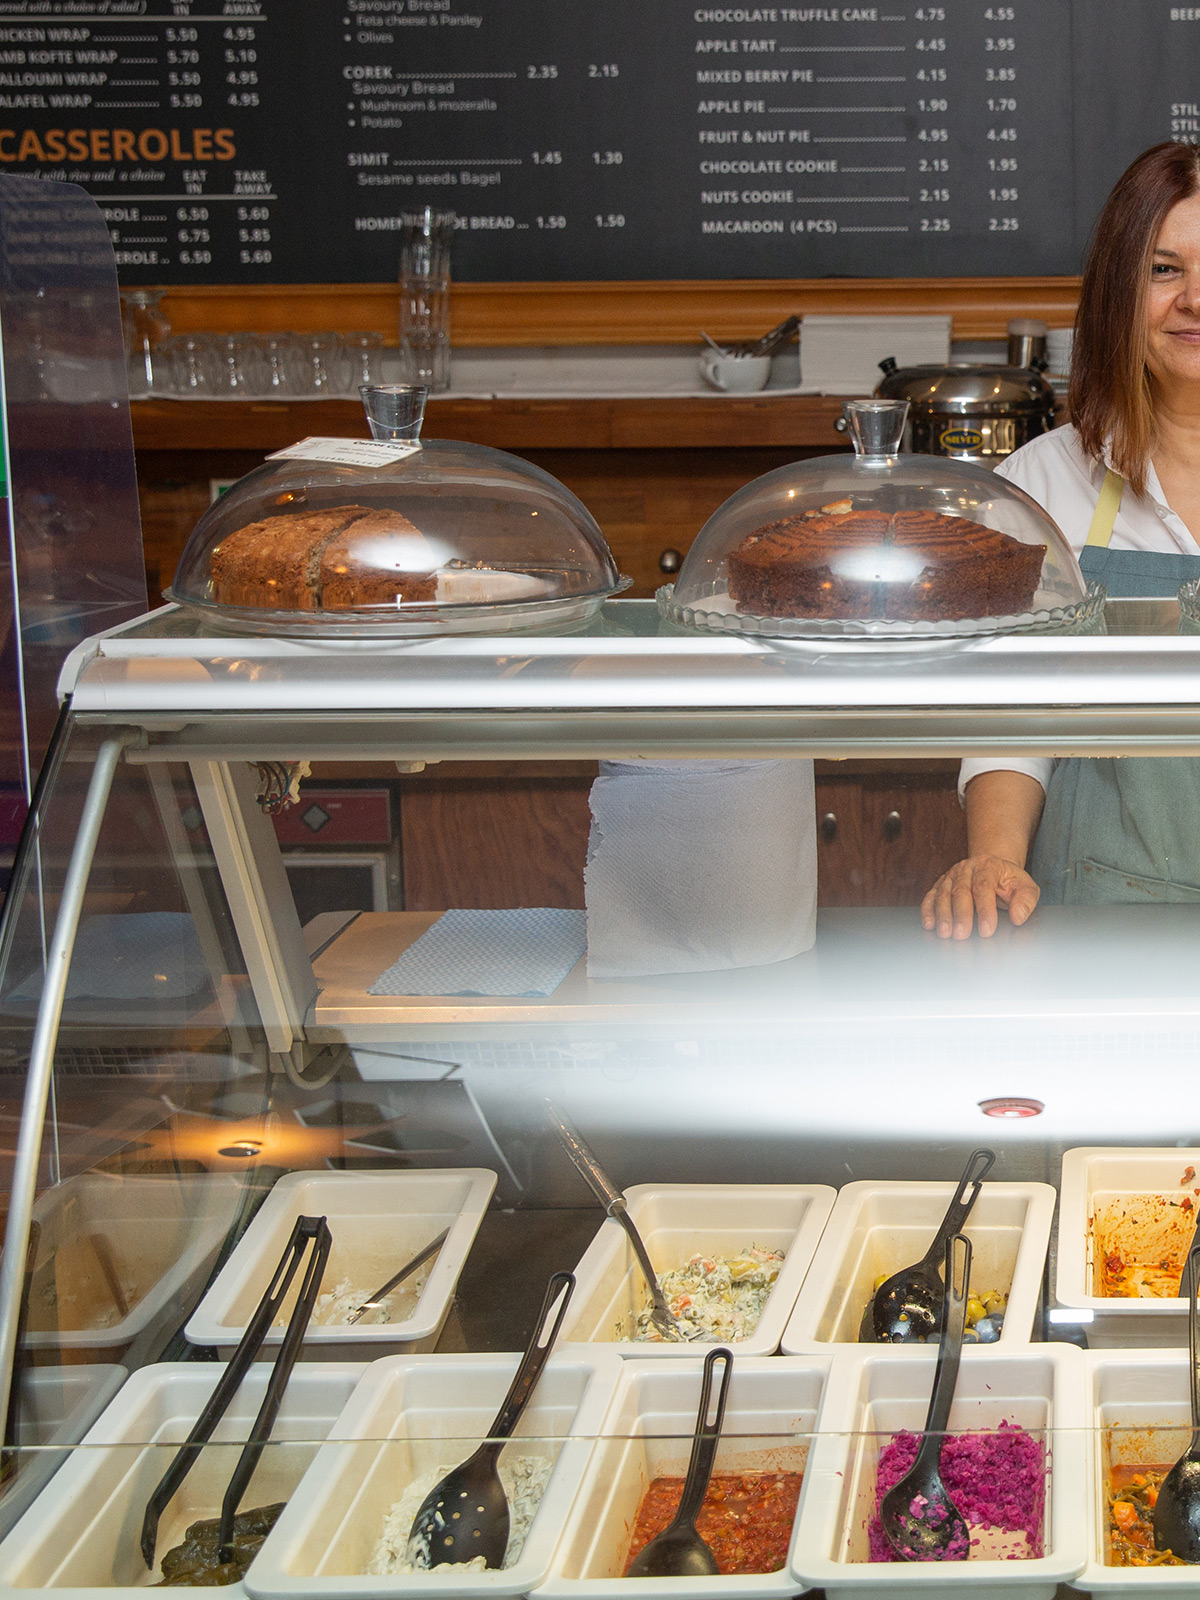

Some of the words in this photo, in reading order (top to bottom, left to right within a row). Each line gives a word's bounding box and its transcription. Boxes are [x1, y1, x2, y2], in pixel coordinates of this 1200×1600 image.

[173, 3, 190, 15] IN
[222, 3, 262, 15] AWAY
[347, 0, 405, 14] Savoury
[408, 0, 450, 11] Bread
[440, 13, 483, 29] Parsley
[694, 8, 778, 23] CHOCOLATE
[781, 8, 840, 22] TRUFFLE
[842, 8, 878, 21] CAKE
[915, 8, 946, 21] 4.75
[984, 8, 1015, 21] 4.55
[48, 28, 90, 41] WRAP
[165, 27, 198, 41] 5.50
[223, 27, 256, 40] 4.95
[357, 31, 394, 43] Olives
[695, 40, 738, 53] APPLE
[740, 40, 777, 53] TART
[915, 38, 946, 51] 4.45
[985, 38, 1016, 51] 3.95
[28, 50, 74, 64] KOFTE
[75, 50, 118, 64] WRAP
[167, 49, 199, 63] 5.70
[225, 49, 257, 62] 5.10
[65, 73, 107, 86] WRAP
[168, 72, 201, 85] 5.50
[226, 71, 258, 84] 4.95
[343, 65, 393, 79] COREK
[527, 65, 558, 78] 2.35
[588, 64, 619, 77] 2.15
[697, 70, 742, 83] MIXED
[745, 70, 789, 83] BERRY
[791, 70, 814, 82] PIE
[916, 68, 947, 81] 4.15
[985, 68, 1016, 81] 3.85
[352, 80, 409, 97] Savoury
[412, 80, 455, 94] Bread
[51, 94, 92, 108] WRAP
[170, 94, 202, 107] 5.50
[227, 93, 259, 106] 4.95
[360, 99, 425, 111] Mushroom
[427, 99, 436, 111] &
[698, 101, 741, 114] APPLE
[743, 101, 765, 113] PIE
[918, 99, 948, 112] 1.90
[987, 99, 1017, 111] 1.70
[361, 115, 402, 128] Potato
[699, 131, 739, 144] FRUIT
[742, 131, 753, 144] &
[756, 131, 786, 143] NUT
[789, 131, 810, 143] PIE
[918, 129, 949, 142] 4.95
[987, 128, 1018, 141] 4.45
[0, 128, 237, 161] CASSEROLES
[348, 152, 389, 166] SIMIT
[532, 151, 562, 164] 1.45
[593, 151, 623, 164] 1.30
[700, 161, 783, 174] CHOCOLATE
[785, 161, 838, 174] COOKIE
[919, 159, 949, 172] 2.15
[988, 159, 1018, 172] 1.95
[182, 170, 207, 182] EAT
[233, 170, 267, 182] TAKE
[357, 172, 414, 186] Sesame
[416, 171, 457, 185] seeds
[460, 171, 501, 187] Bagel
[186, 183, 202, 194] IN
[233, 183, 272, 194] AWAY
[701, 191, 739, 204] NUTS
[741, 190, 794, 203] COOKIE
[920, 189, 950, 202] 2.15
[989, 189, 1019, 201] 1.95
[177, 207, 209, 221] 6.50
[237, 207, 269, 220] 5.60
[469, 216, 515, 230] BREAD
[536, 215, 567, 228] 1.50
[595, 214, 625, 227] 1.50
[702, 221, 784, 234] MACAROON
[807, 220, 837, 235] PCS)
[920, 219, 951, 232] 2.25
[989, 218, 1019, 231] 2.25
[178, 229, 210, 242] 6.75
[239, 228, 271, 242] 5.85
[179, 250, 212, 264] 6.50
[240, 249, 272, 263] 5.60
